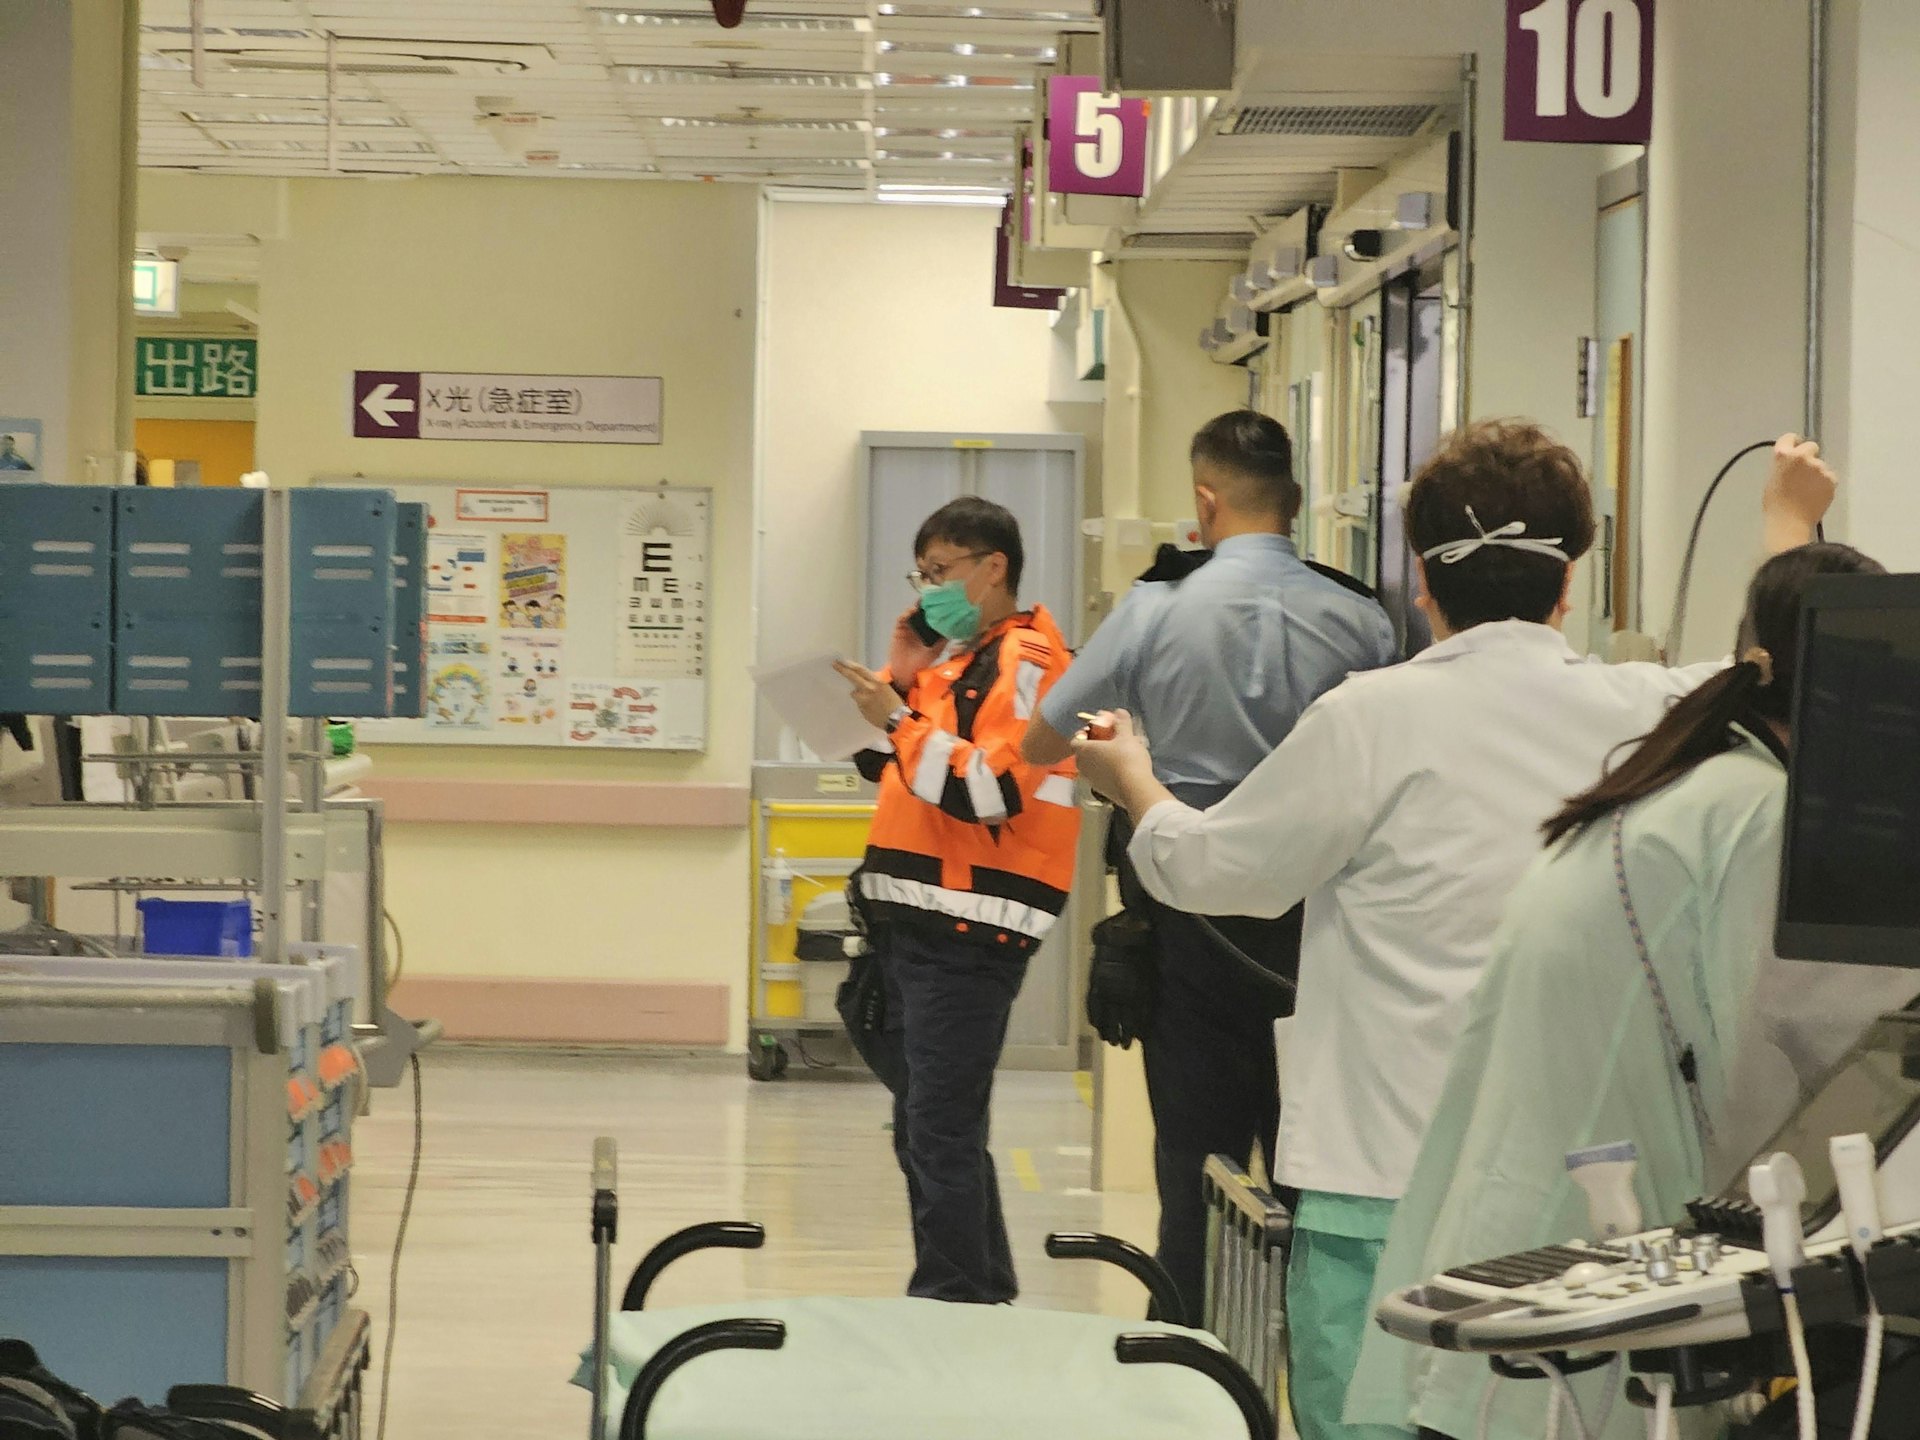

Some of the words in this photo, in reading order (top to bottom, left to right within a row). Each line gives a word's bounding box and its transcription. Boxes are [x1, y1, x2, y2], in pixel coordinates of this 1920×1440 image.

[1519, 0, 1642, 118] 10
[1074, 91, 1124, 179] 5
[144, 342, 253, 396] 出路
[510, 419, 521, 430] &
[523, 419, 582, 433] Emergency
[641, 542, 672, 572] E
